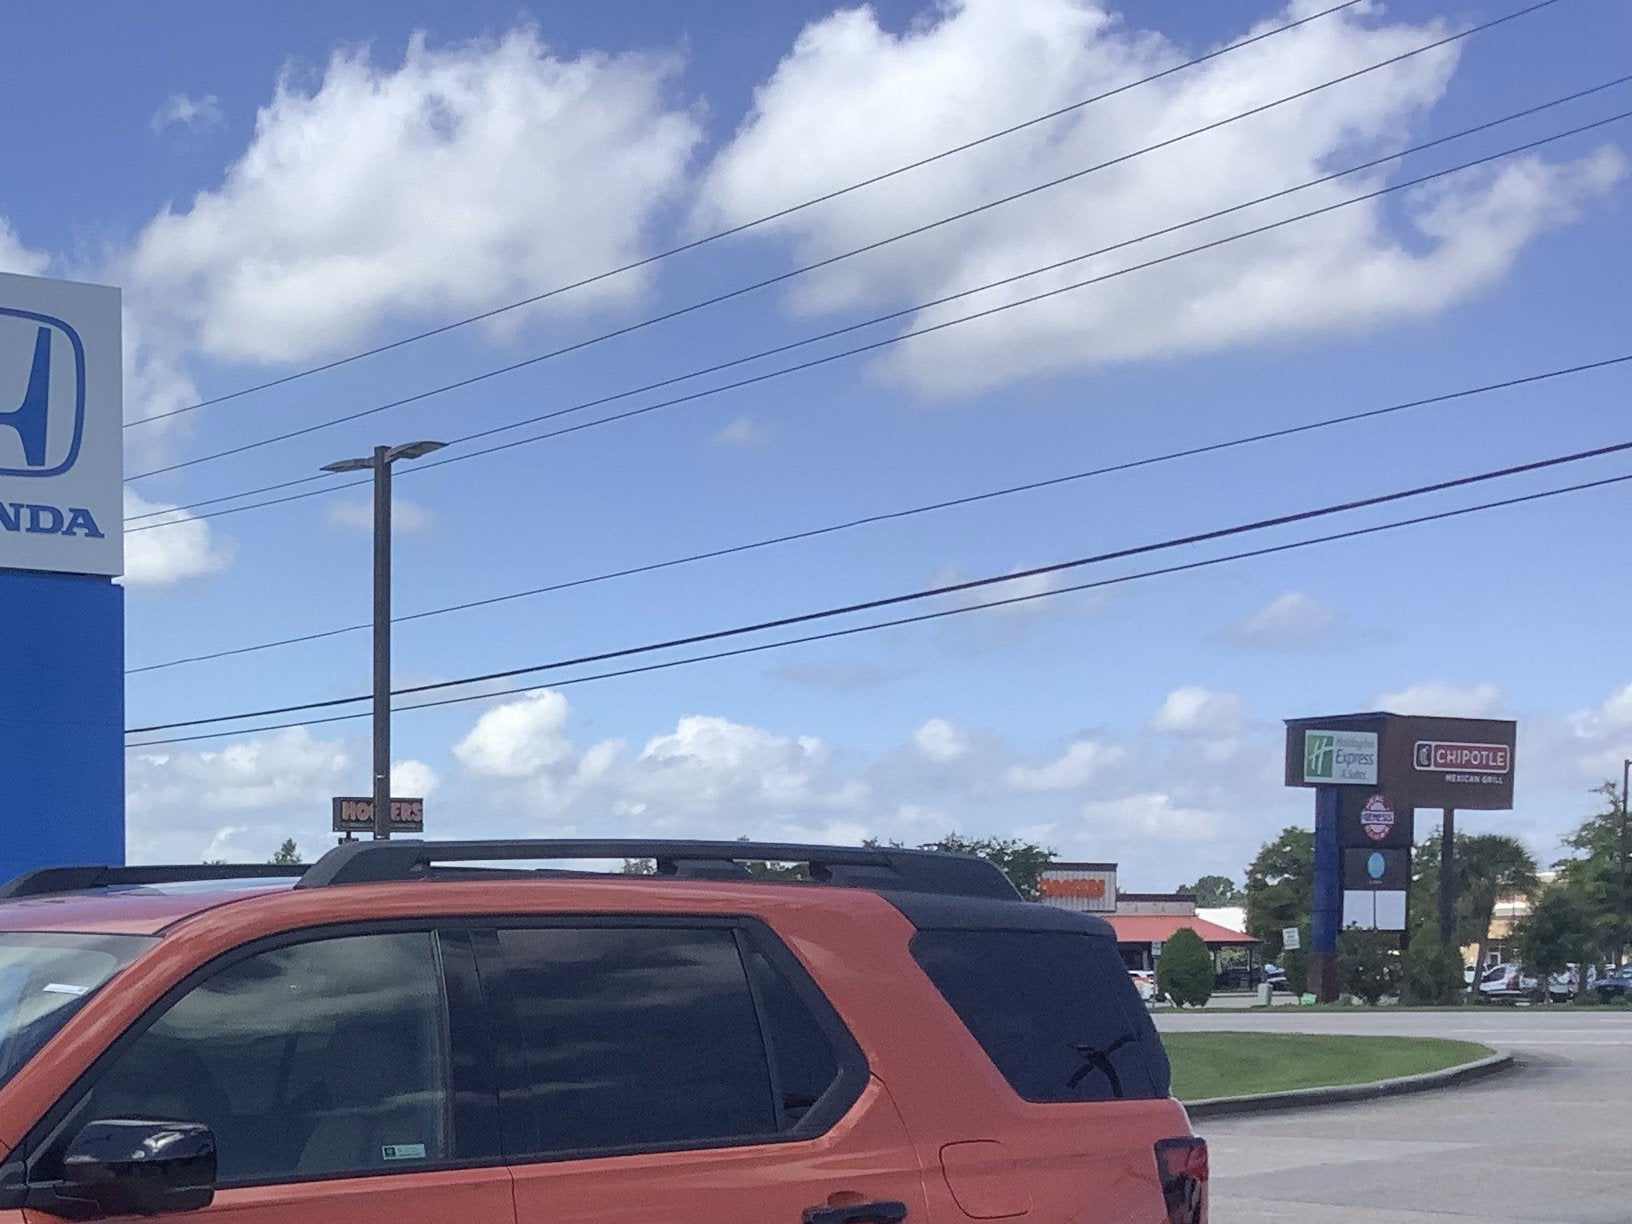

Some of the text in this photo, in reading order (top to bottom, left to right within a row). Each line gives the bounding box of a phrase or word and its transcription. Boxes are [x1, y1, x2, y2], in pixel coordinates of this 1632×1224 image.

[1335, 748, 1374, 767] Express
[1436, 749, 1506, 766] CHIPOTLE
[1445, 773, 1503, 784] MEXICAN GRILL
[341, 801, 422, 821] HOERS
